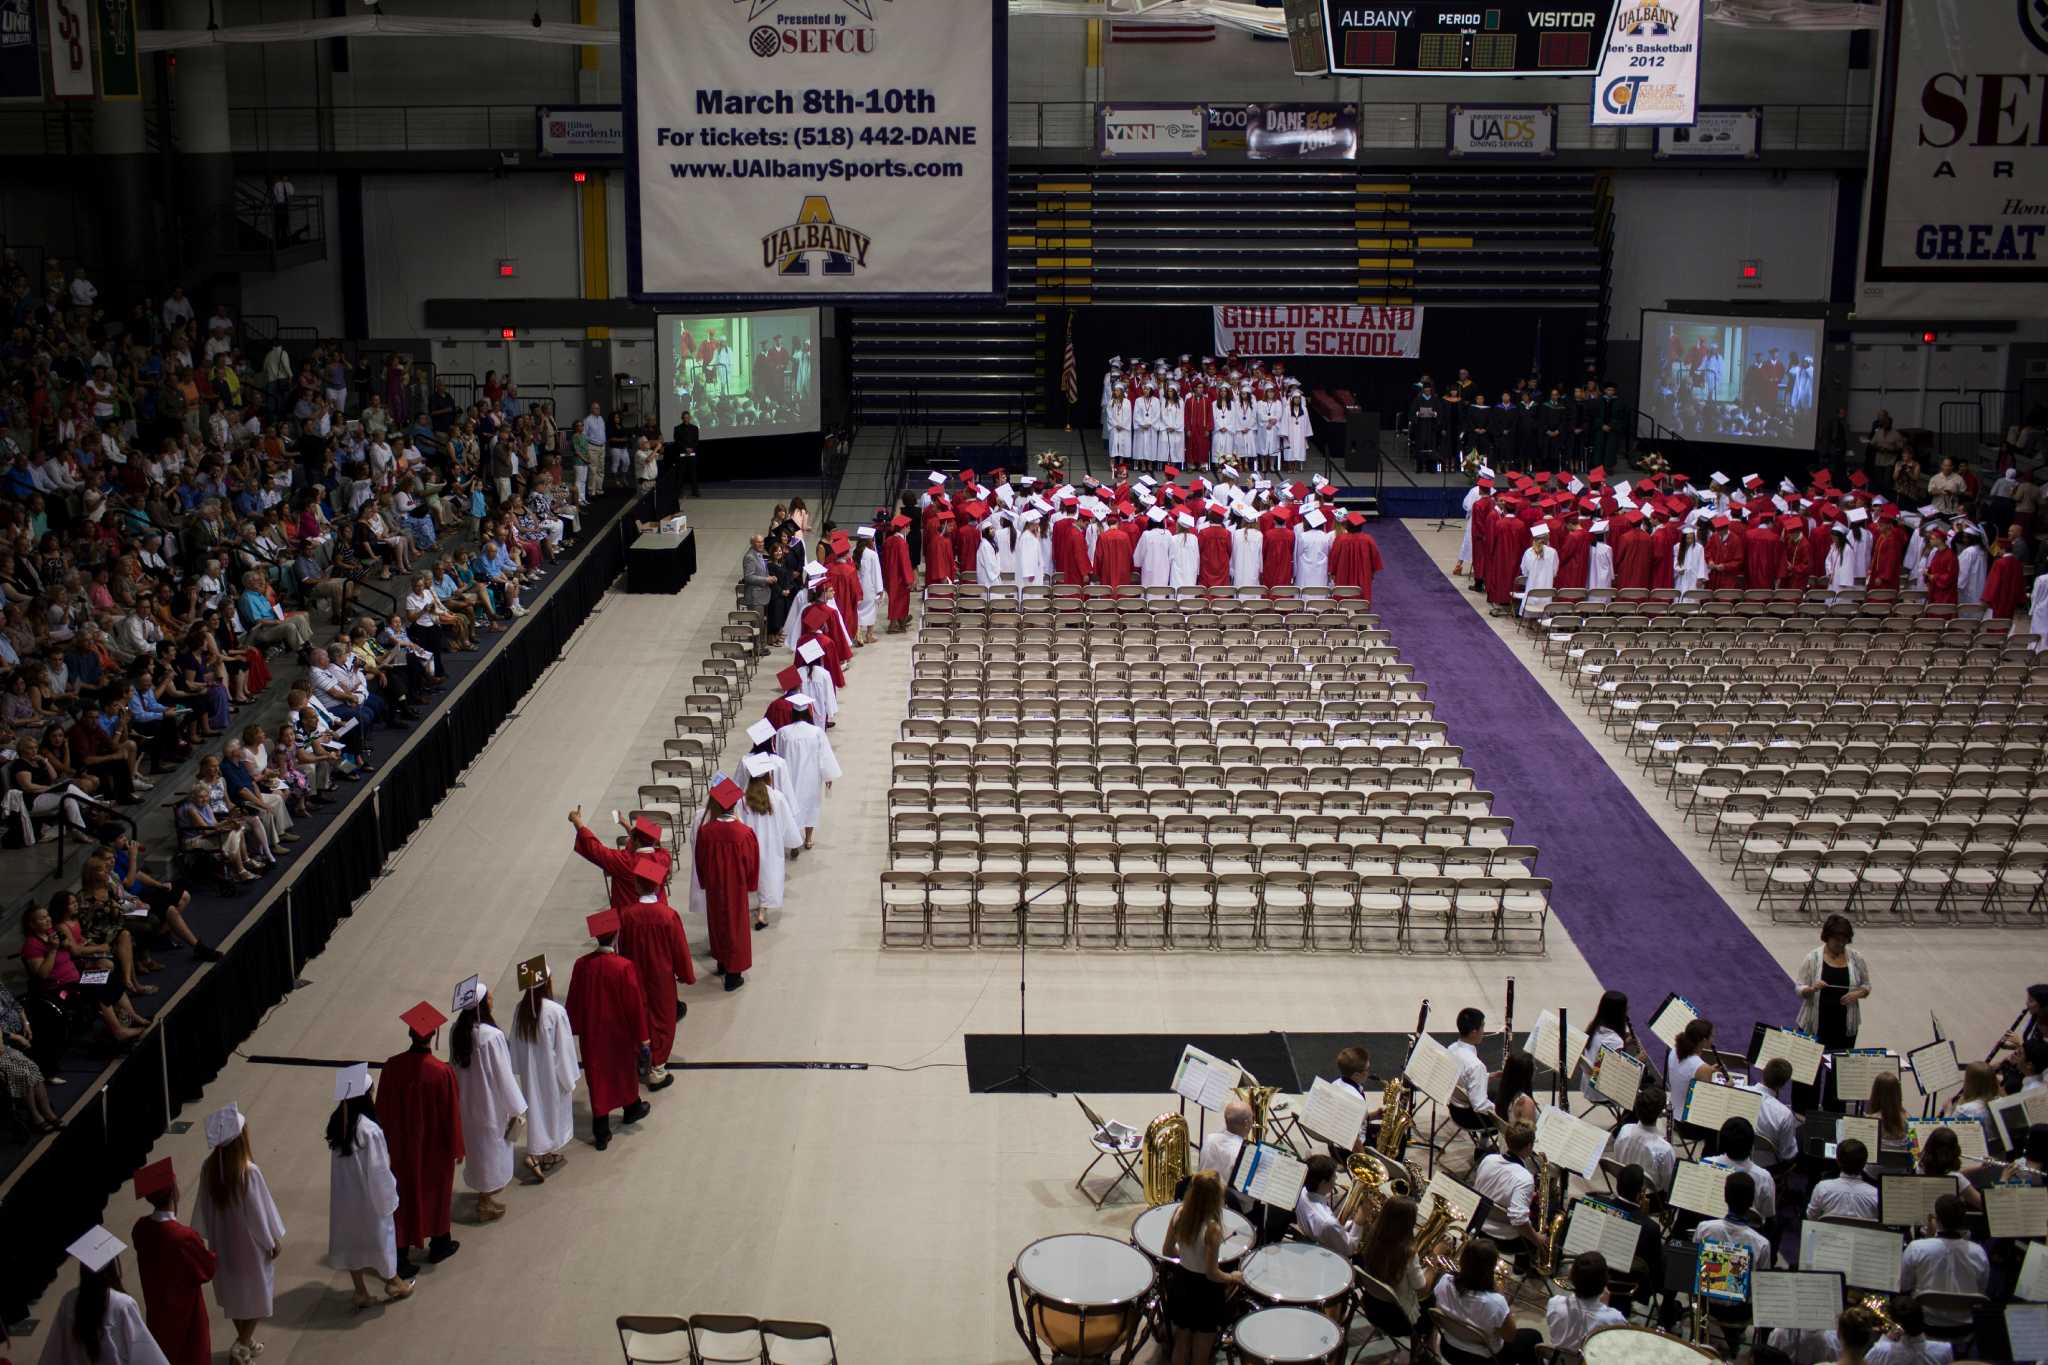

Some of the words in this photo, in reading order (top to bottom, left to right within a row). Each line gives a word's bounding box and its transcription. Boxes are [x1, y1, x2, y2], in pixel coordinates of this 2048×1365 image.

[777, 14, 832, 25] Presented
[835, 14, 846, 26] by
[1341, 10, 1413, 27] ALBANY
[1438, 13, 1481, 25] PERIOD
[1527, 11, 1596, 28] VISITOR
[1618, 7, 1679, 32] UALBANY
[781, 28, 876, 54] SEFCU
[1636, 43, 1692, 53] Basketball
[1629, 56, 1665, 67] 2012
[695, 89, 794, 115] March
[802, 88, 936, 115] 8th-10th
[567, 120, 592, 129] Hilton
[567, 128, 608, 138] Garden
[1107, 124, 1155, 140] YNN
[1470, 119, 1536, 141] UADS
[656, 128, 695, 146] For
[700, 127, 788, 146] tickets:
[793, 126, 854, 150] (518)
[859, 126, 977, 146] 442-DANE
[1470, 140, 1497, 148] DINING
[1499, 140, 1534, 148] SERVICES
[670, 158, 963, 181] www.UAlbanySports.com
[2000, 198, 2048, 216] Hom
[761, 224, 872, 268] UALBANY
[1915, 224, 2046, 260] GREAT
[1223, 305, 1415, 331] GUILDERLAND
[1233, 331, 1296, 355] HIGH
[1305, 331, 1404, 356] SCHOOL
